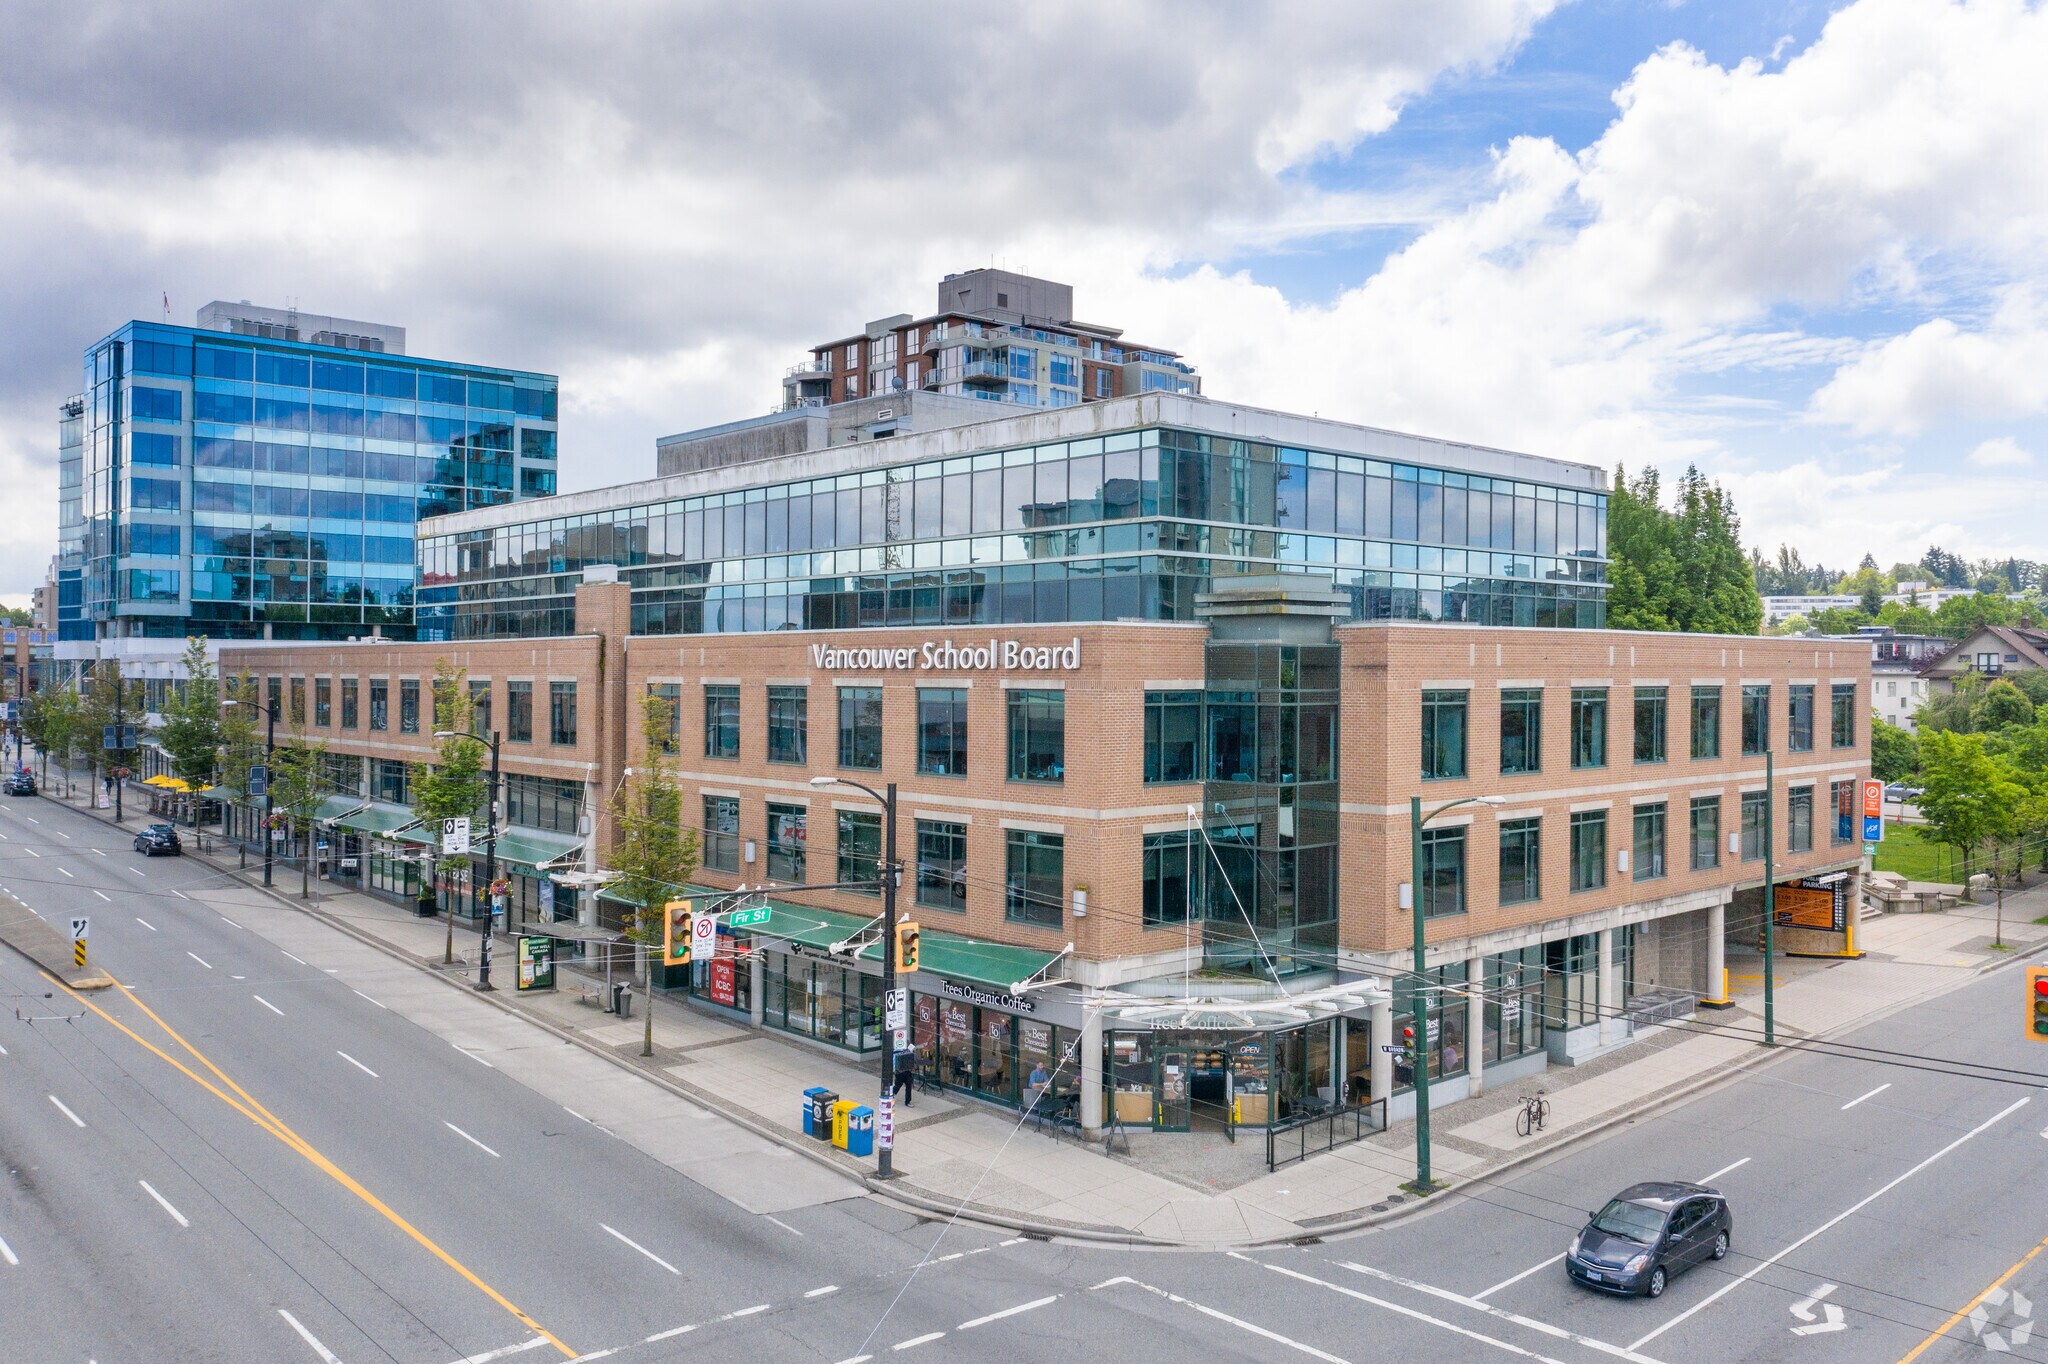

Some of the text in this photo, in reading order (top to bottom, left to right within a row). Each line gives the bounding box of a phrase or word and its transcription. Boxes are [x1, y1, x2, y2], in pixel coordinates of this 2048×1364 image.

[812, 637, 1081, 670] Vancouver School Board
[1803, 881, 1832, 890] PARKING
[735, 910, 766, 924] Fir St
[840, 959, 855, 967] gallery
[716, 965, 730, 975] OPEN
[715, 979, 732, 992] ICBC
[941, 980, 1032, 1013] Trees Organic Coffee
[952, 1010, 966, 1023] Best
[1032, 1028, 1048, 1042] Best
[1240, 1045, 1260, 1054] OPEN
